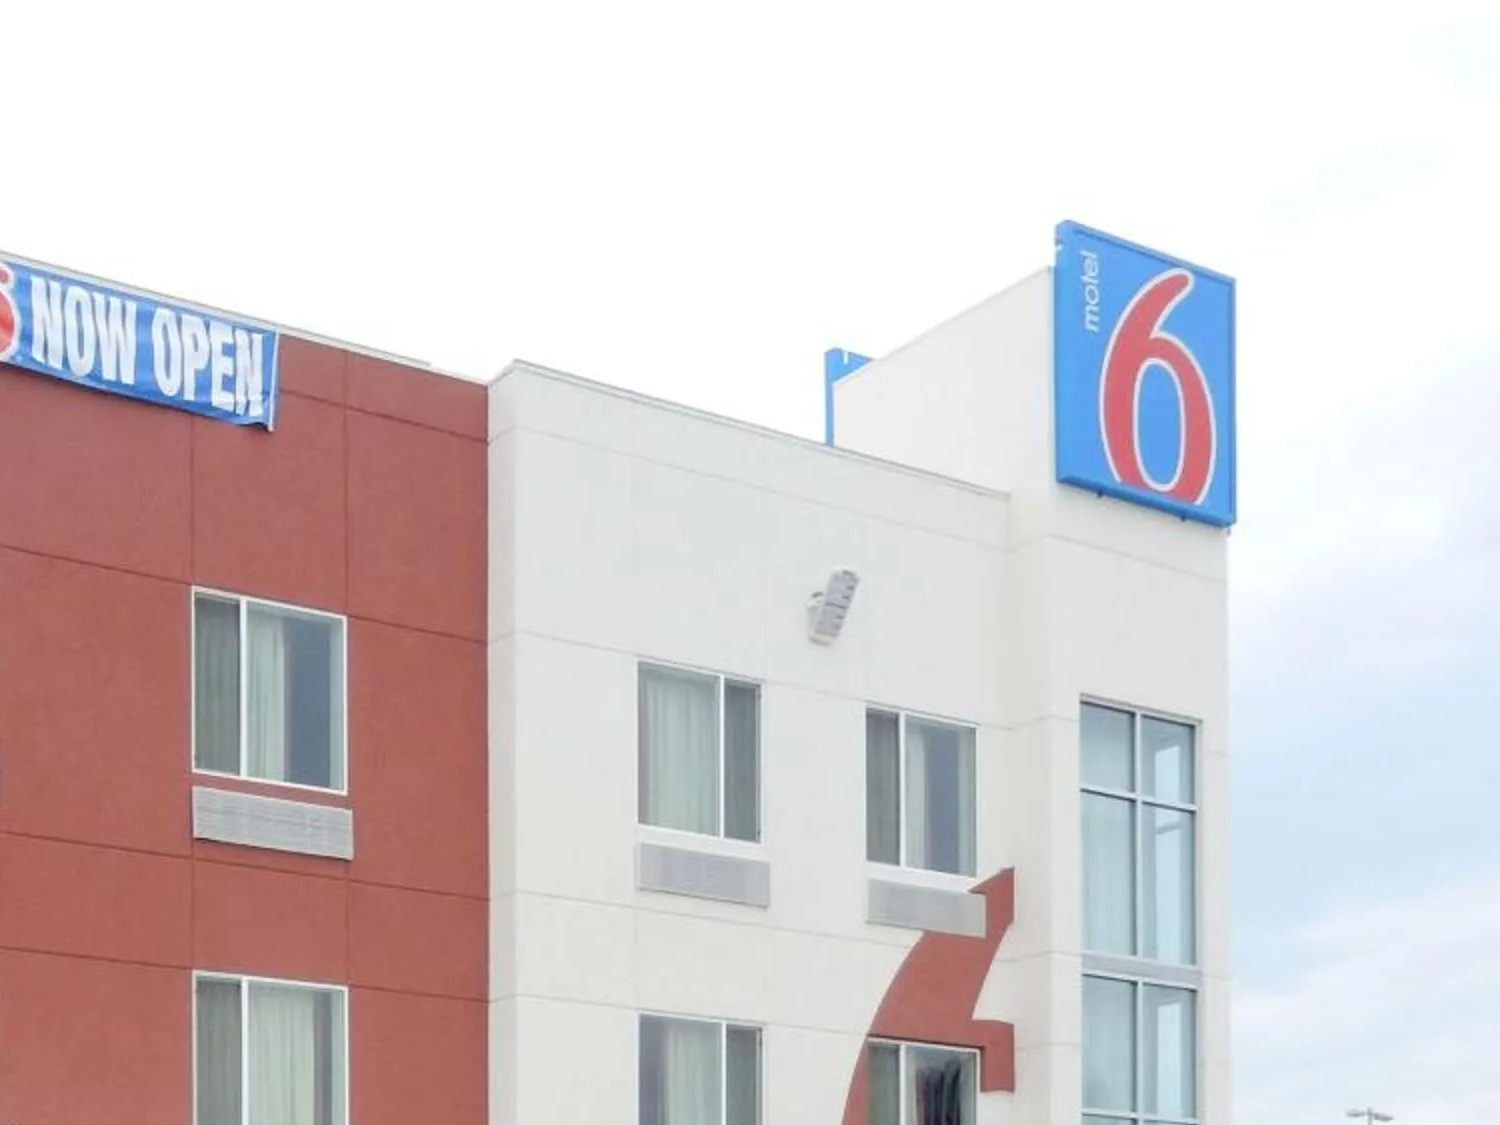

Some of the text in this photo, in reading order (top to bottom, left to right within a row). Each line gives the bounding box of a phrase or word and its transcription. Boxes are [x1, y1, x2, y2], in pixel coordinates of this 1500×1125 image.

[30, 275, 137, 385] NOW
[150, 307, 264, 416] OPEN
[1080, 250, 1101, 333] motel
[1100, 267, 1217, 505] 6
